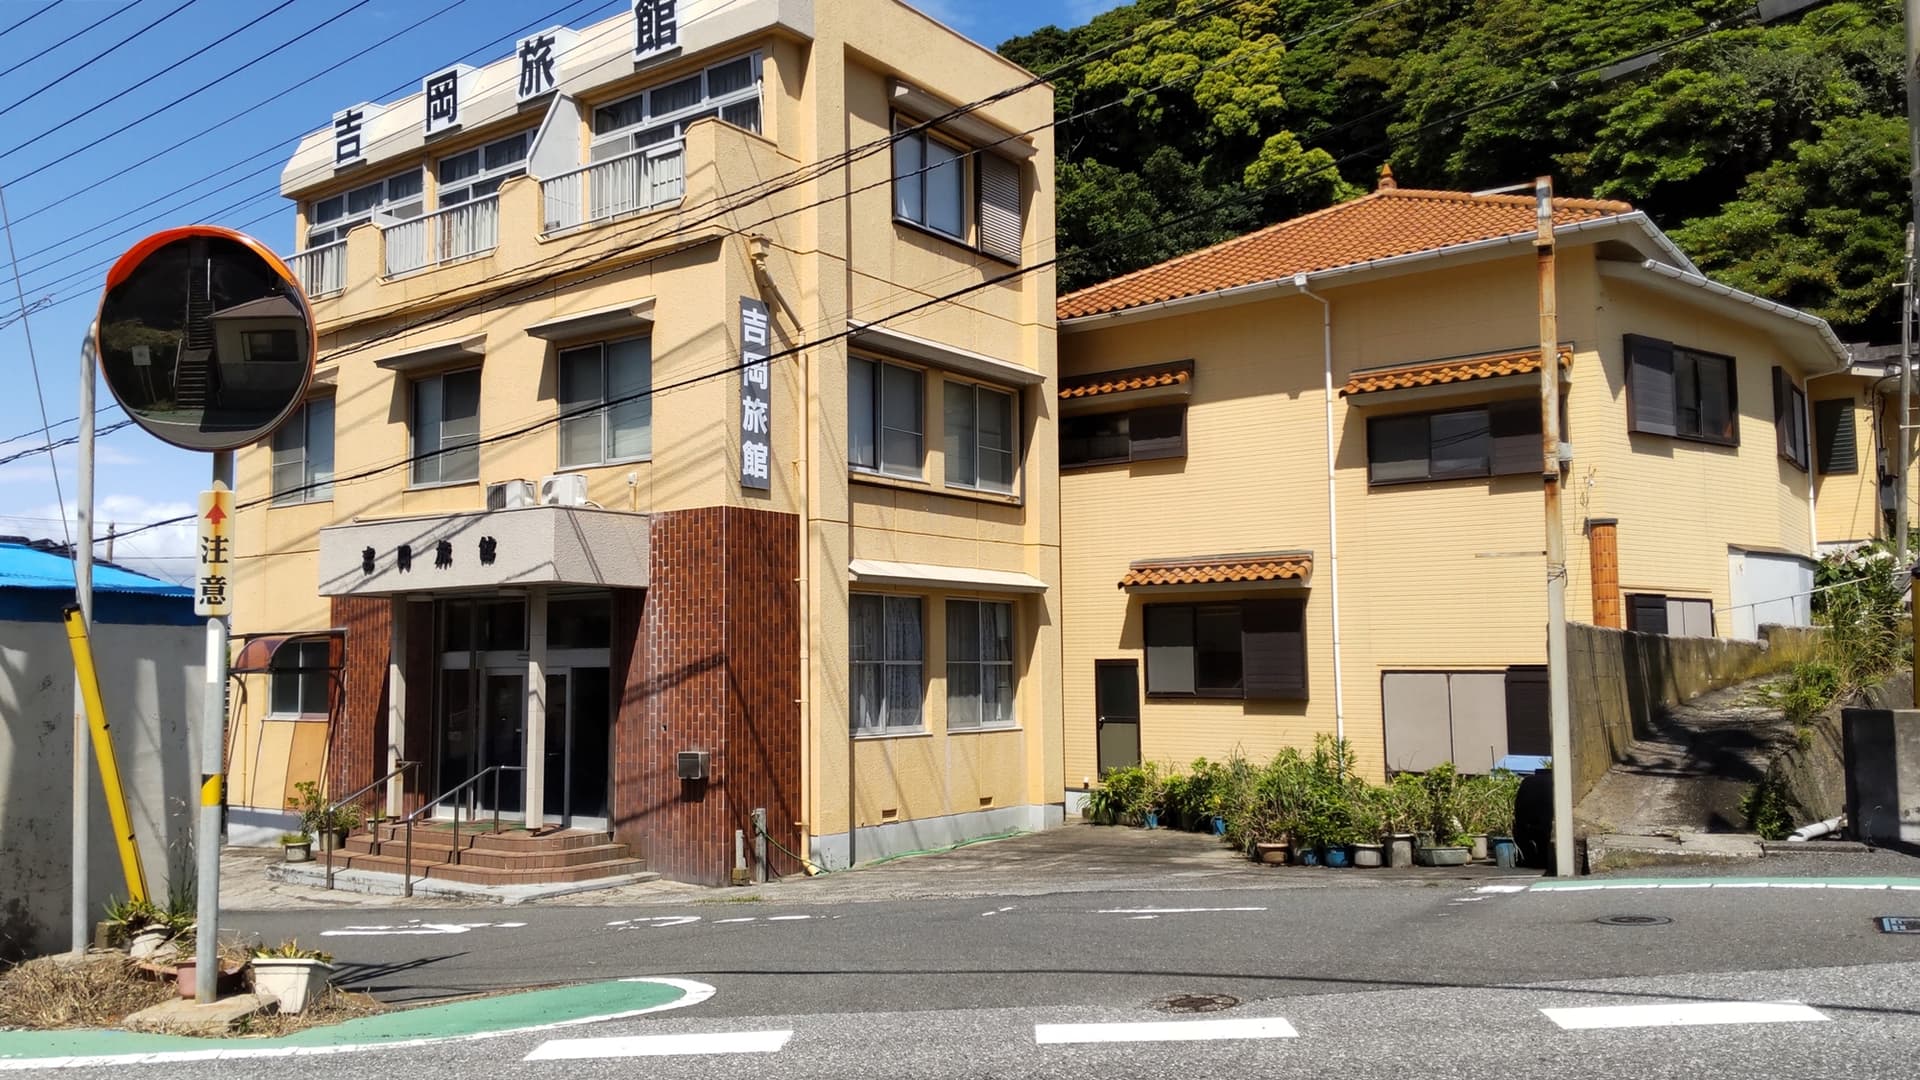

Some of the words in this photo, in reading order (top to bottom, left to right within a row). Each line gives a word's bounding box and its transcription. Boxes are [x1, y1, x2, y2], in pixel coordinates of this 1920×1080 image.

[335, 0, 677, 163] 吉岡旅館
[742, 308, 768, 480] 吉岡旅館
[200, 535, 229, 605] 注意
